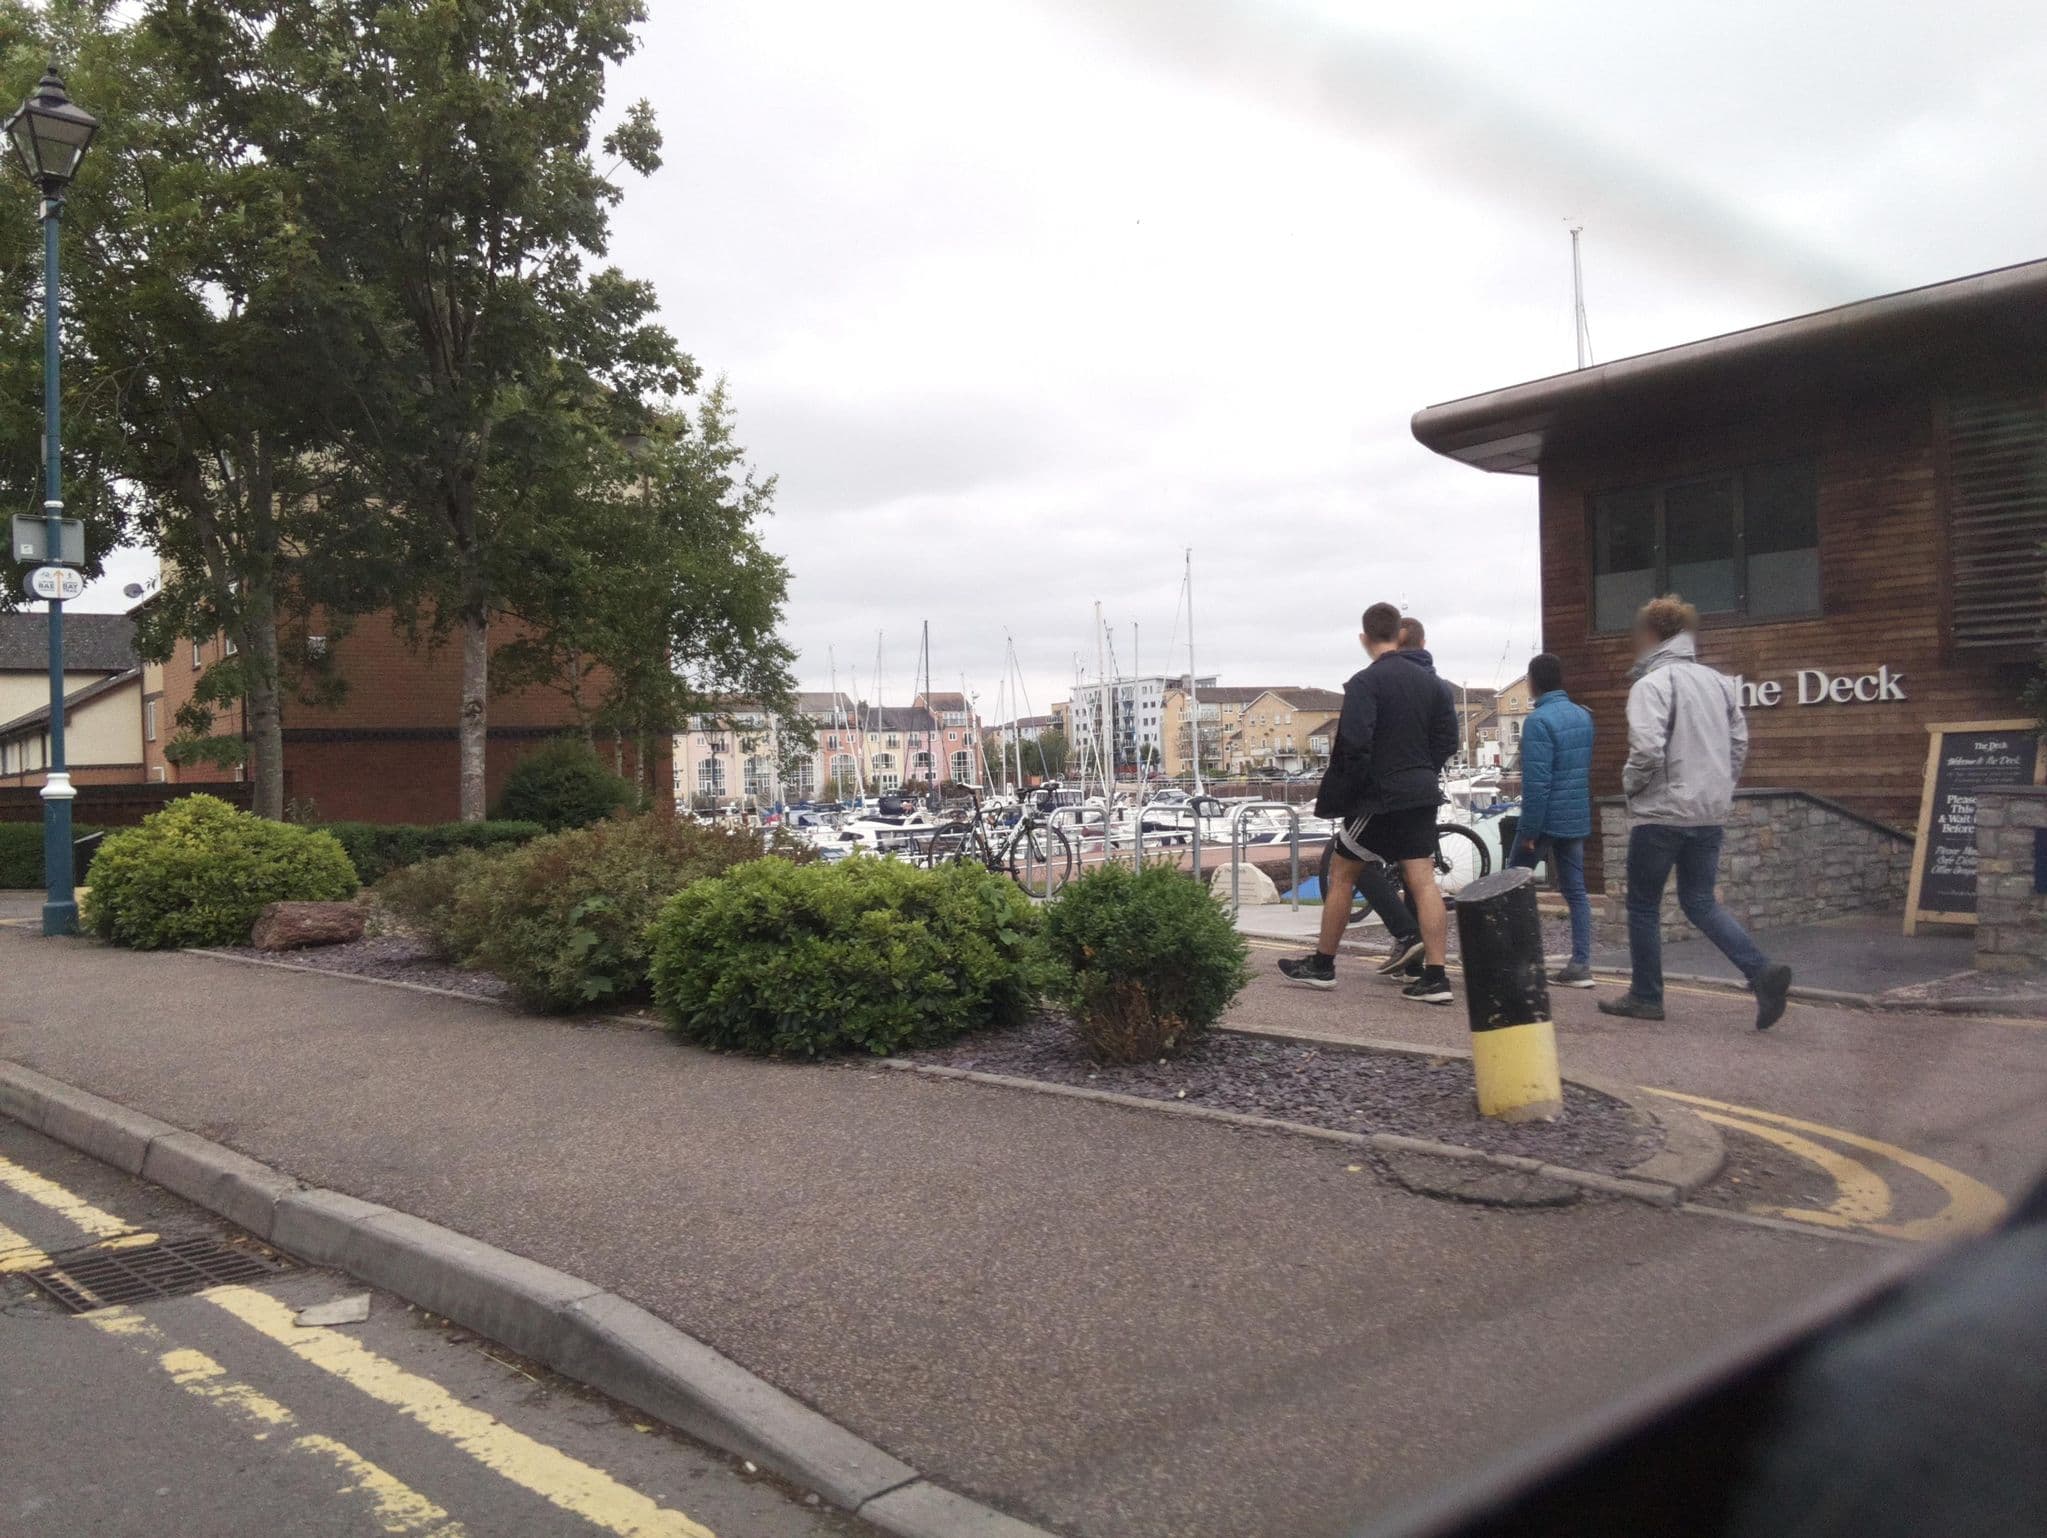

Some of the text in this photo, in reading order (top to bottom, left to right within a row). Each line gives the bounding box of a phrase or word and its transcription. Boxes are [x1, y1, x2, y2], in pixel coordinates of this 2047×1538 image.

[1734, 664, 1908, 707] he Deck
[1938, 814, 1946, 823] &
[1948, 814, 1971, 823] Wait
[1942, 823, 1975, 834] Before
